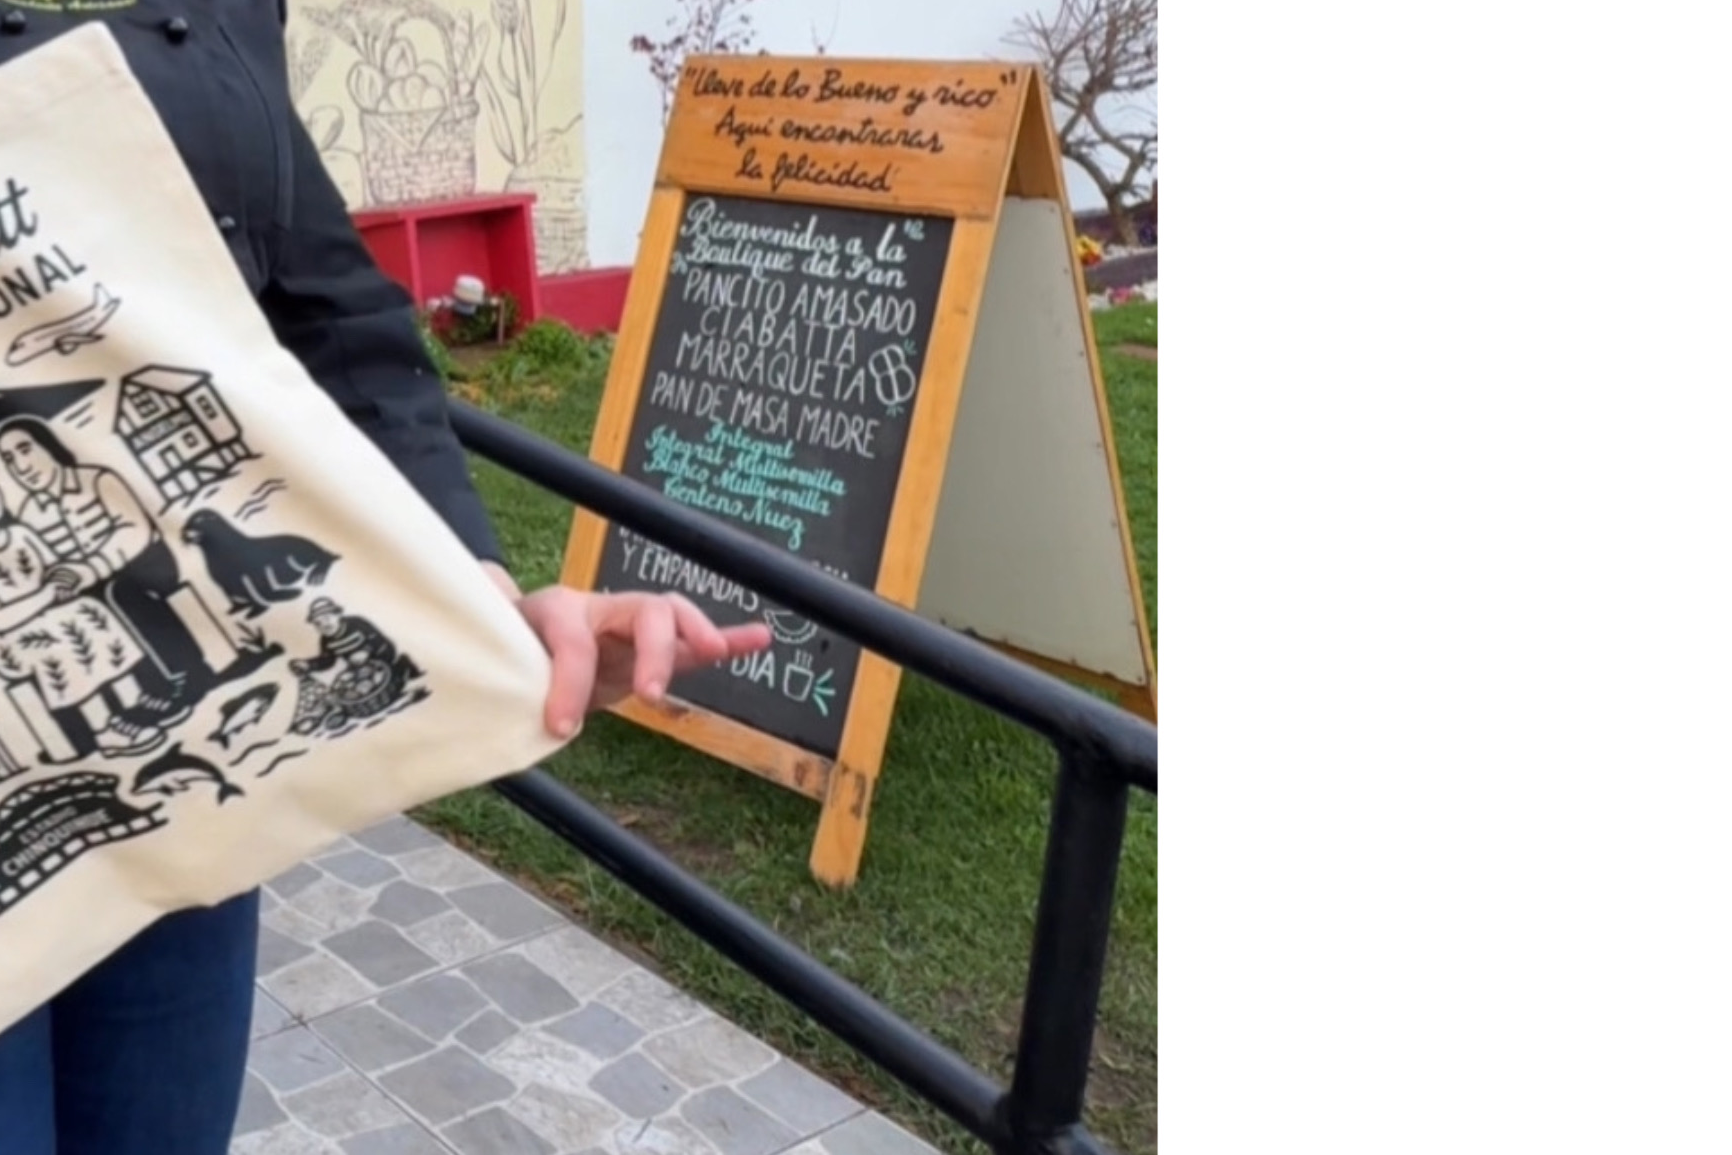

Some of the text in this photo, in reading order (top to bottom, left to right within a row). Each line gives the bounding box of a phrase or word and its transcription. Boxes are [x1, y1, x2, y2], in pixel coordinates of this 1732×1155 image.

[748, 69, 777, 98] de
[779, 69, 811, 98] lo
[813, 68, 901, 103] Bueno
[902, 85, 928, 116] y
[780, 117, 945, 154] encontraras
[735, 148, 893, 193] la felicidad
[679, 196, 907, 262] Bienvenidos a la
[685, 236, 907, 289] Boutique del Pan
[682, 266, 917, 336] PANCITO AMASADO
[699, 306, 857, 364] CIABATTA
[674, 330, 866, 404] MARRAQUETA
[650, 371, 880, 459] PAN DE MASA MADRE
[704, 417, 795, 459] Integral
[644, 424, 727, 464] Integral
[663, 476, 805, 551] Centeno Nuez
[622, 540, 636, 572] Y
